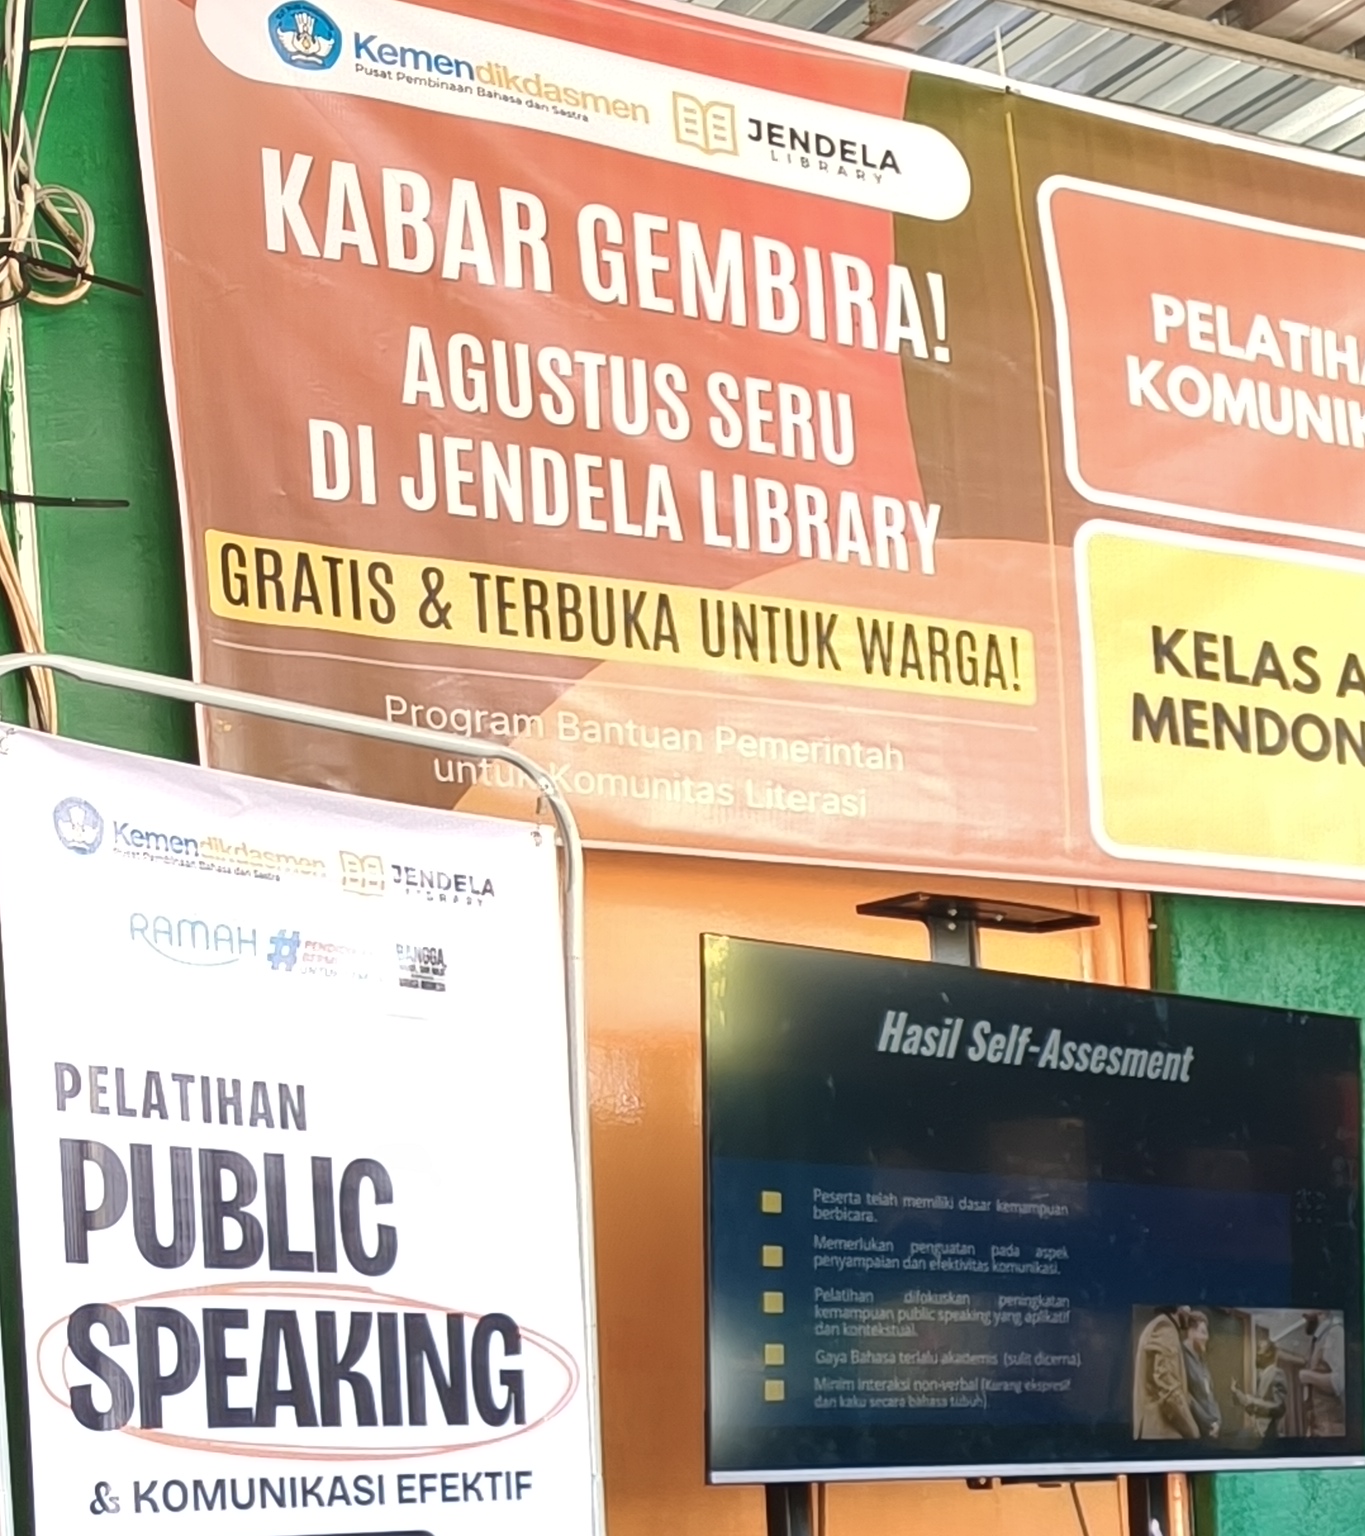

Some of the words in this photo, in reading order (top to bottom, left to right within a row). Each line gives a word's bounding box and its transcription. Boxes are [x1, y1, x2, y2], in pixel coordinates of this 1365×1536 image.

[353, 31, 651, 124] Kemendikdasmen
[355, 63, 393, 81] Pusat
[396, 70, 474, 96] Pembinaan
[477, 86, 523, 106] Bahasa
[526, 98, 549, 113] dan
[747, 117, 902, 175] JENDELA
[770, 150, 884, 185] LIBRARY
[260, 148, 552, 293] KABAR
[576, 203, 953, 364] GEMBIRA!
[402, 326, 692, 442] AGUSTUS
[707, 369, 858, 467] SERU
[308, 419, 379, 508] DI
[400, 437, 684, 543] JENDELA
[699, 468, 943, 576] LIBRARY
[219, 541, 397, 627] GRATIS
[418, 565, 453, 631] &
[468, 571, 682, 656] TERBUKA
[699, 596, 843, 674] UNTUK
[856, 617, 1024, 693] WARGA!
[1150, 625, 1321, 697] KELAS
[384, 693, 544, 747] Program
[556, 710, 704, 756] Bantuan
[714, 726, 907, 774] Pemerintah
[550, 764, 737, 811] Komunitas
[744, 774, 868, 820] Literasi
[391, 864, 496, 897] JENDELA
[129, 912, 257, 957] RAMAH
[877, 1010, 963, 1060] Hasil
[967, 1020, 1195, 1084] Self-Assesment
[54, 1062, 307, 1131] PELATIHAN
[59, 1138, 398, 1277] PUBLIC
[813, 1188, 862, 1205] Peserta
[866, 1192, 898, 1208] telah
[903, 1195, 954, 1210] memiliki
[958, 1196, 991, 1212] dasar
[996, 1199, 1069, 1219] kemampuan
[813, 1205, 878, 1223] berbicara.
[813, 1234, 894, 1252] Memerlukan
[910, 1242, 976, 1260] penguatan
[991, 1244, 1020, 1262] pada
[1035, 1246, 1069, 1261] aspek
[813, 1254, 900, 1272] penyampaian
[903, 1255, 926, 1270] dan
[929, 1255, 989, 1273] efektivitas
[992, 1259, 1061, 1275] komunikasi.
[814, 1286, 874, 1303] Pelatihan
[904, 1290, 970, 1306] difokuskan
[998, 1294, 1070, 1311] peningkatan
[814, 1304, 895, 1322] kemampuan
[897, 1307, 935, 1323] public
[937, 1309, 991, 1326] speaking
[993, 1312, 1023, 1327] yang
[1024, 1310, 1071, 1327] aplikatif
[814, 1321, 840, 1336] dan
[67, 1302, 527, 1431] SPEAKING
[815, 1349, 848, 1368] Gaya
[850, 1349, 896, 1365] Bahasa
[899, 1350, 938, 1365] terlalu
[940, 1351, 999, 1366] akademis
[814, 1394, 838, 1409] dan
[869, 1396, 907, 1409] secara
[913, 1377, 979, 1393] non-verbal
[89, 1481, 121, 1515] &
[133, 1473, 385, 1513] KOMUNIKASI
[397, 1470, 533, 1504] EFEKTIF
